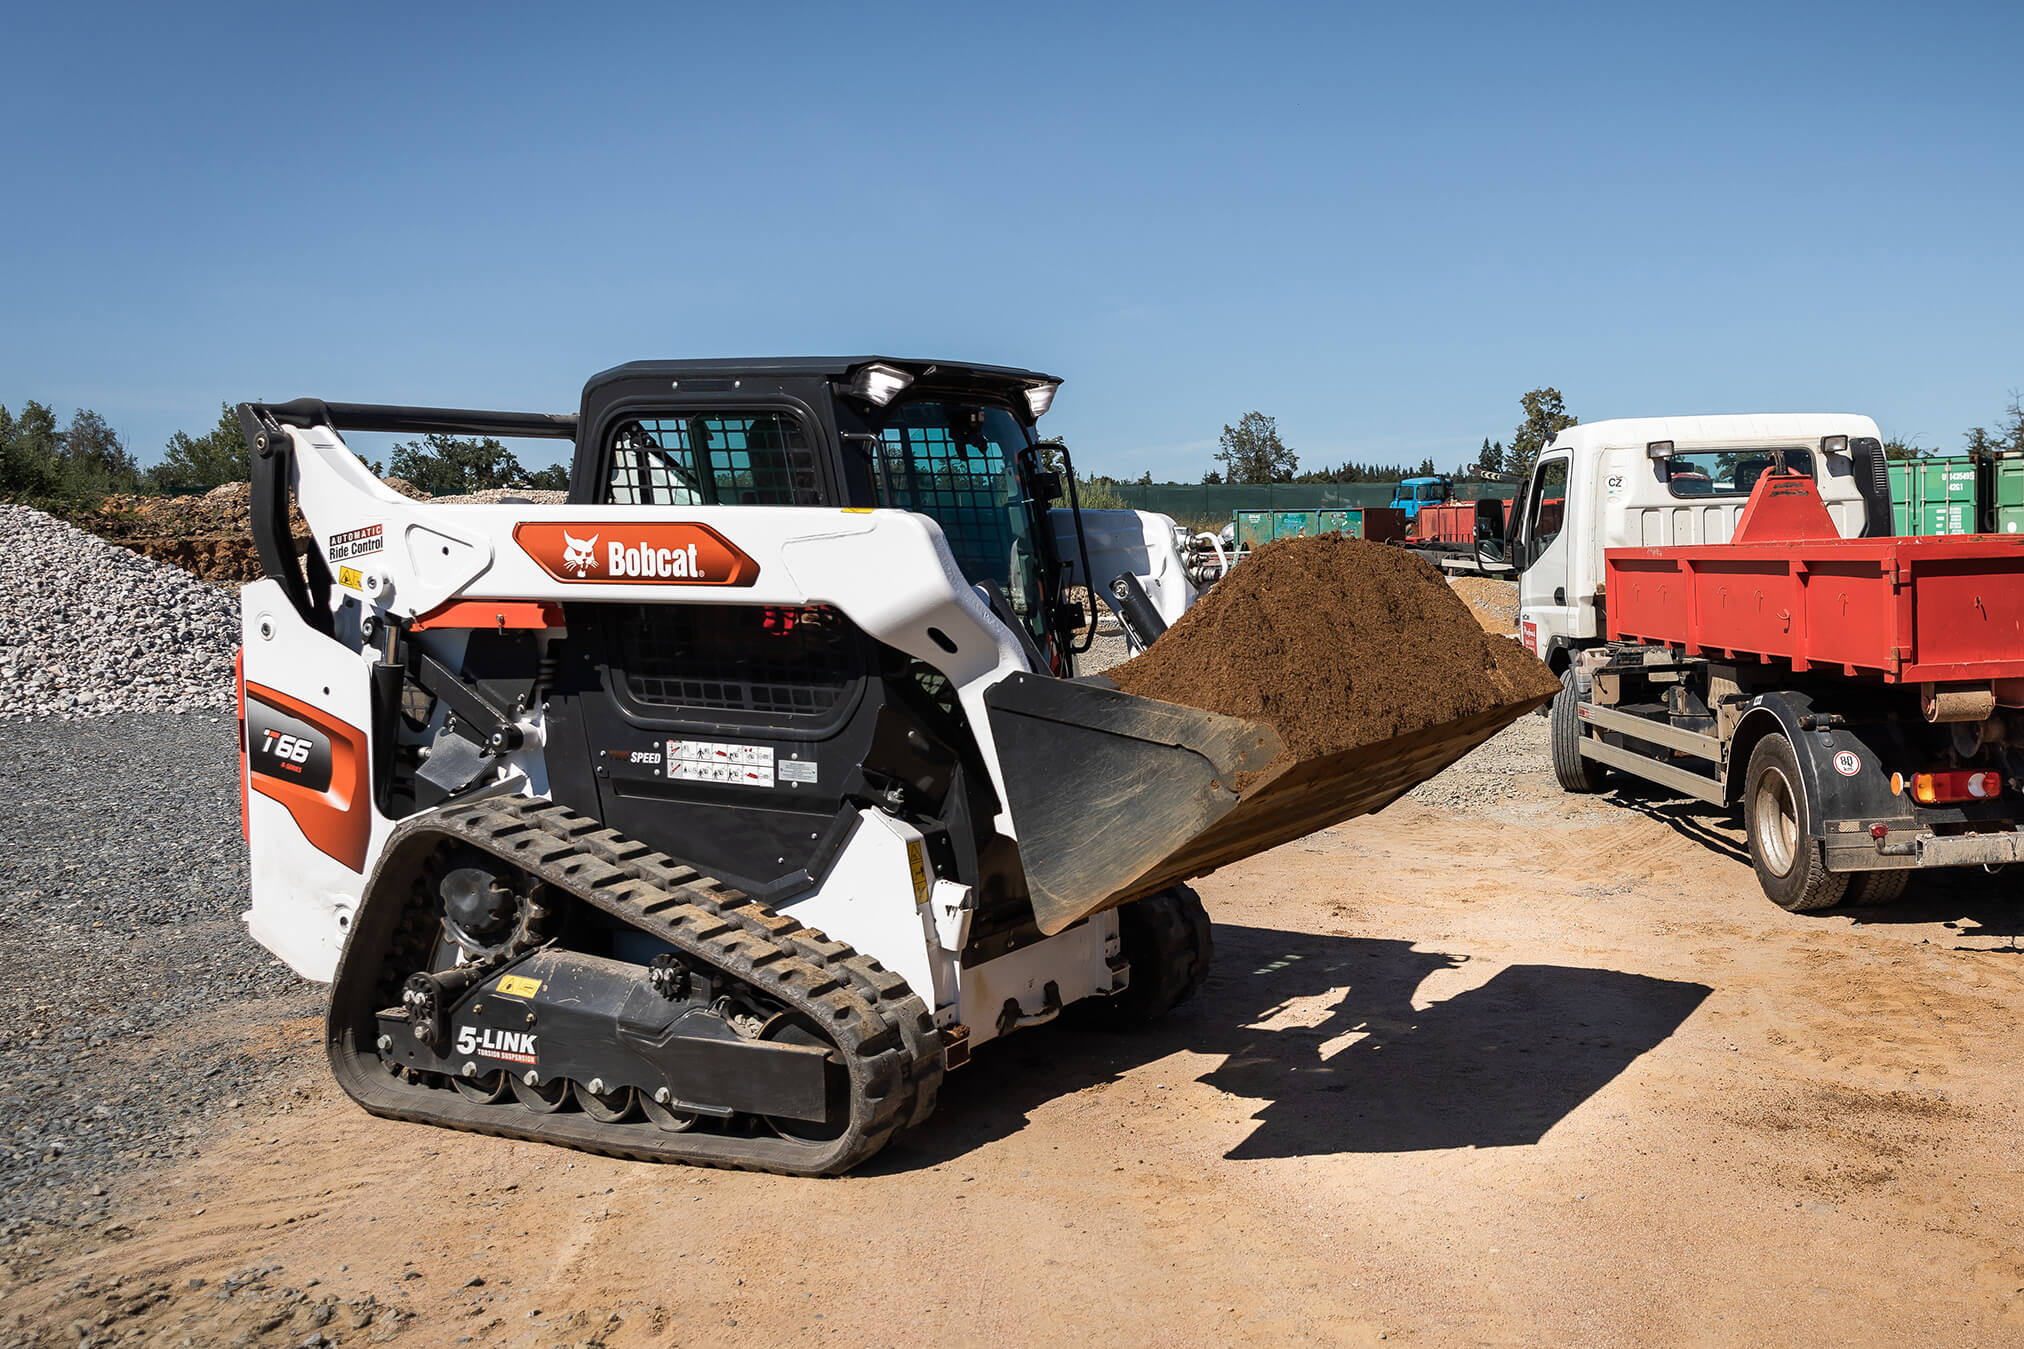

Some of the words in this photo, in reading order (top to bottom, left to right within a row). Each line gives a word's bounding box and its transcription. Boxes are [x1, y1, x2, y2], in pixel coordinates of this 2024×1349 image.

[1608, 477, 1622, 487] CZ
[331, 525, 382, 546] AUTOMATIC
[329, 545, 349, 560] Ride
[351, 536, 383, 555] Control
[608, 541, 698, 577] Bobcat
[262, 728, 313, 763] T66
[630, 751, 661, 764] SPEED
[456, 1025, 538, 1055] 5-LINK
[500, 1051, 536, 1064] SUSPENSION
